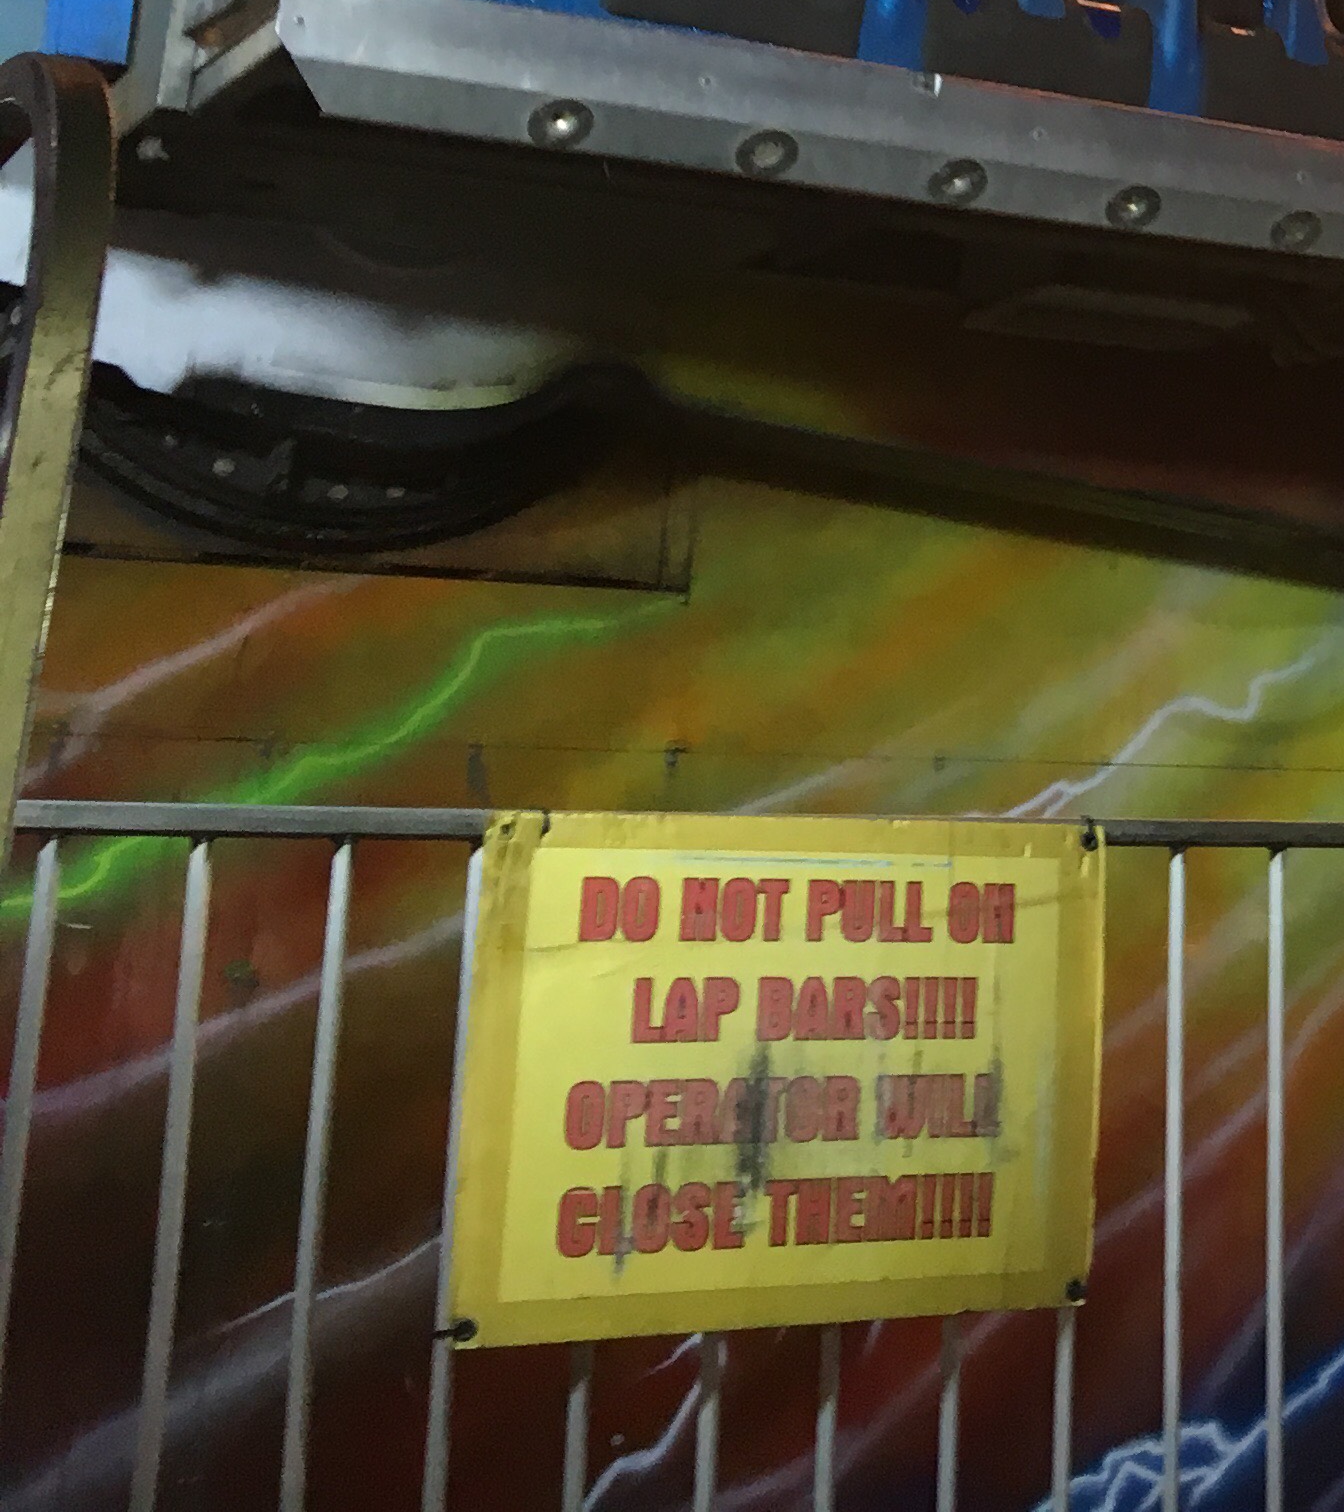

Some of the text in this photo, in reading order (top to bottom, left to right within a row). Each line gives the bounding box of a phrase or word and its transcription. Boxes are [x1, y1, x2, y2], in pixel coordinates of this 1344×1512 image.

[578, 875, 1016, 944] DO NOT PULL ON
[630, 975, 979, 1043] LAP BARS!!!!
[563, 1075, 860, 1150] OPERATOR
[556, 1172, 996, 1257] CLOSE THEM!!!!
